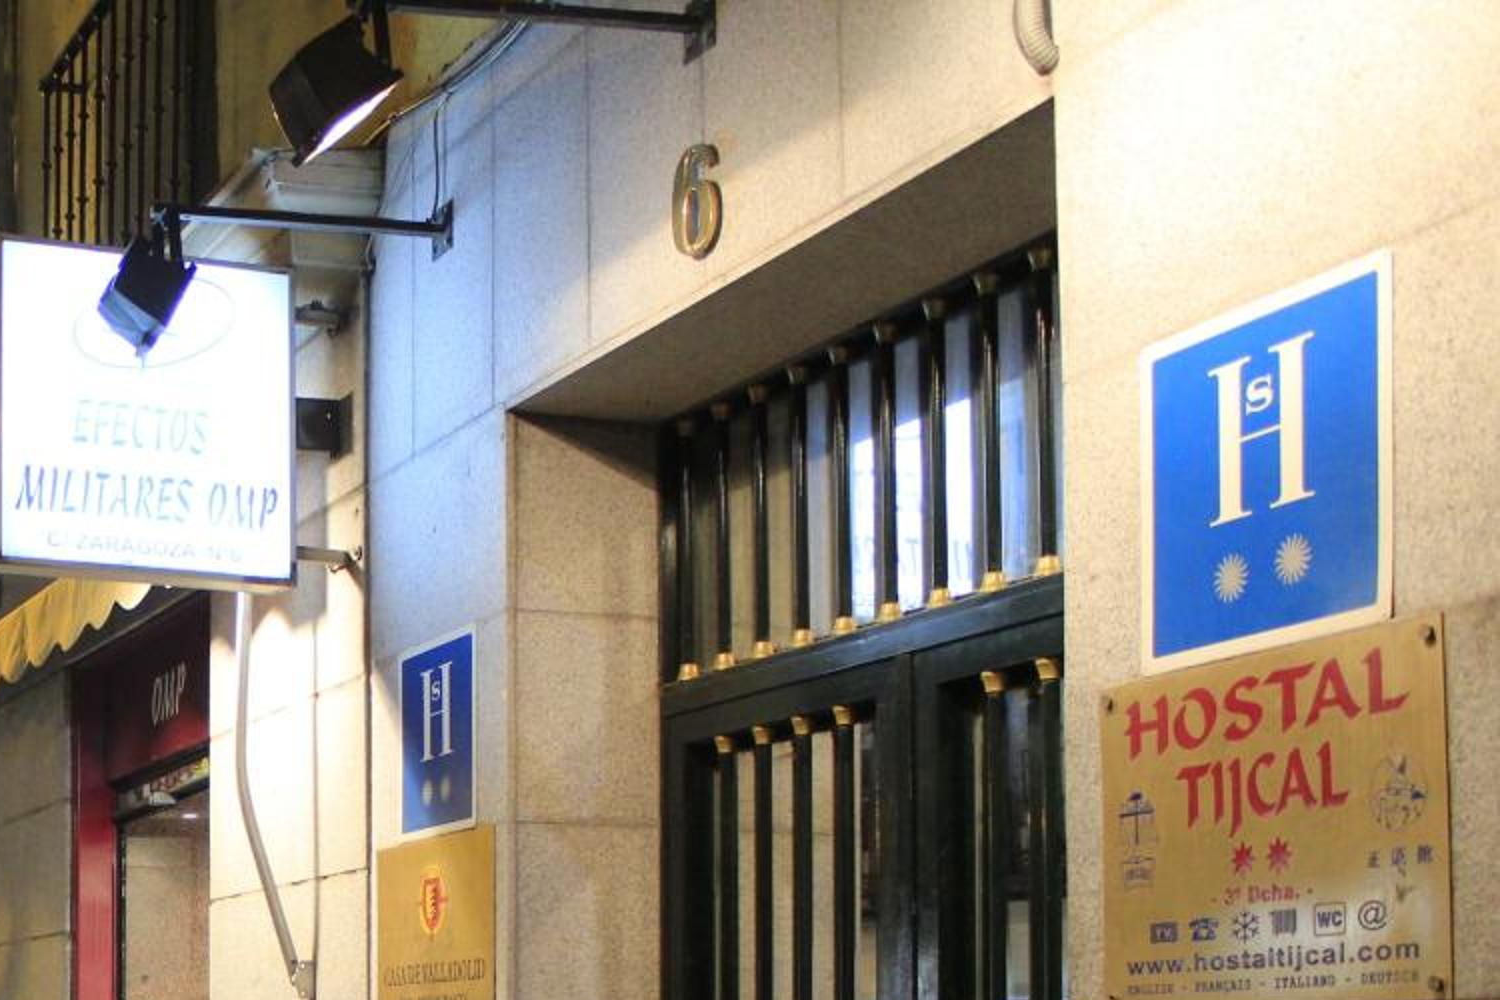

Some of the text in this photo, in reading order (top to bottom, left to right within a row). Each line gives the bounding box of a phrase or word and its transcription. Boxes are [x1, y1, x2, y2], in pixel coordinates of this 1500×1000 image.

[671, 143, 723, 260] 6
[71, 399, 210, 455] EFECTOS
[15, 464, 279, 530] MILITARES OMP
[151, 661, 186, 728] OMP
[1124, 648, 1409, 761] HOSTAL
[1177, 741, 1350, 838] TIJCAL
[1317, 910, 1343, 929] WC
[1127, 942, 1420, 975] www.hostaltijcal.com
[1275, 975, 1336, 989] ITALIANO
